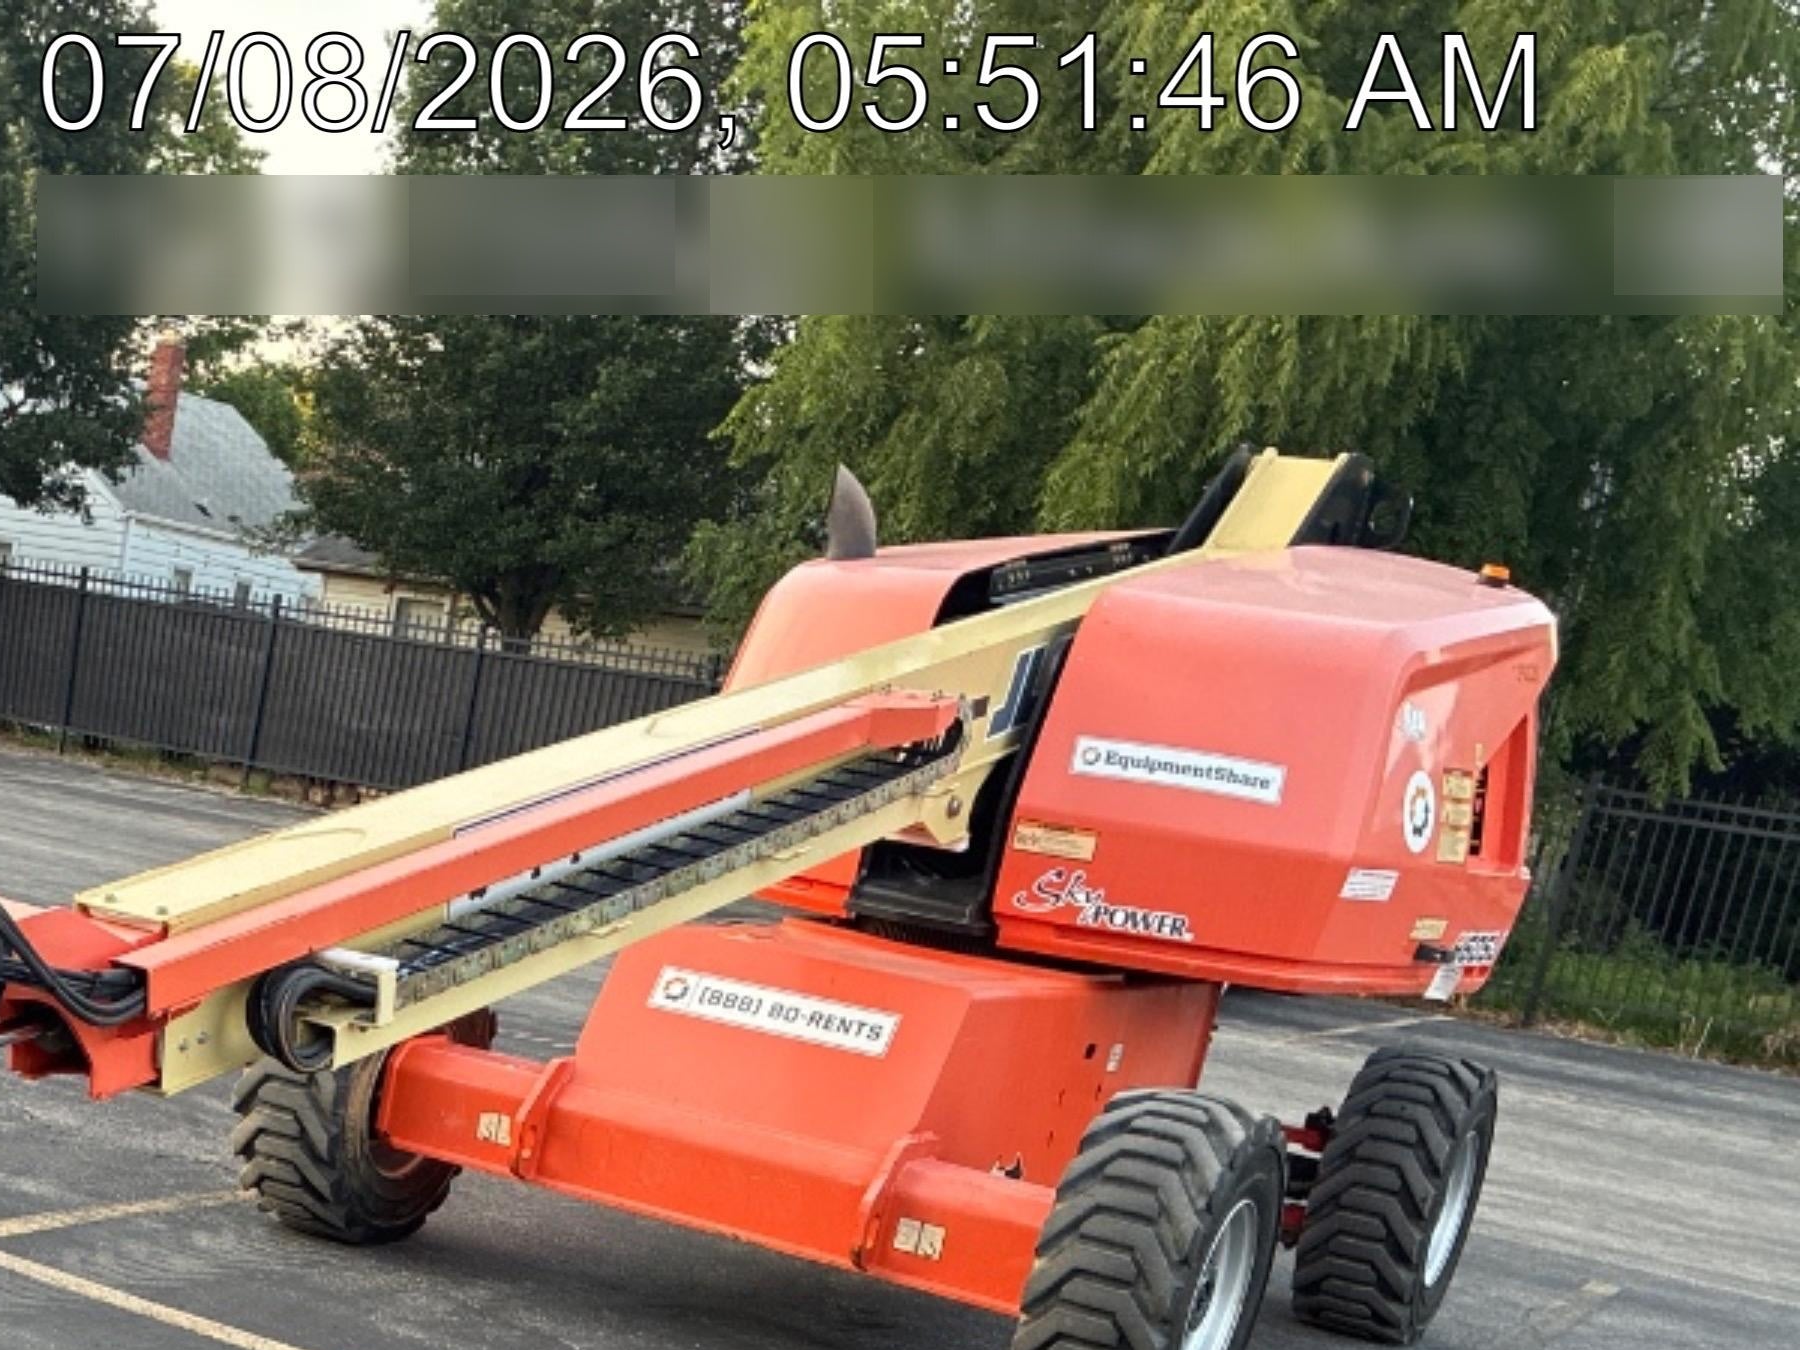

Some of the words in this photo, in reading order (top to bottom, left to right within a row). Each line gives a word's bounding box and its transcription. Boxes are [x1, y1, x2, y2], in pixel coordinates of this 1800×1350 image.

[1104, 749, 1272, 790] EquipmentShare
[1089, 902, 1189, 938] POWER
[699, 985, 764, 1017] (888)
[767, 1001, 886, 1042] 80-RENTS
